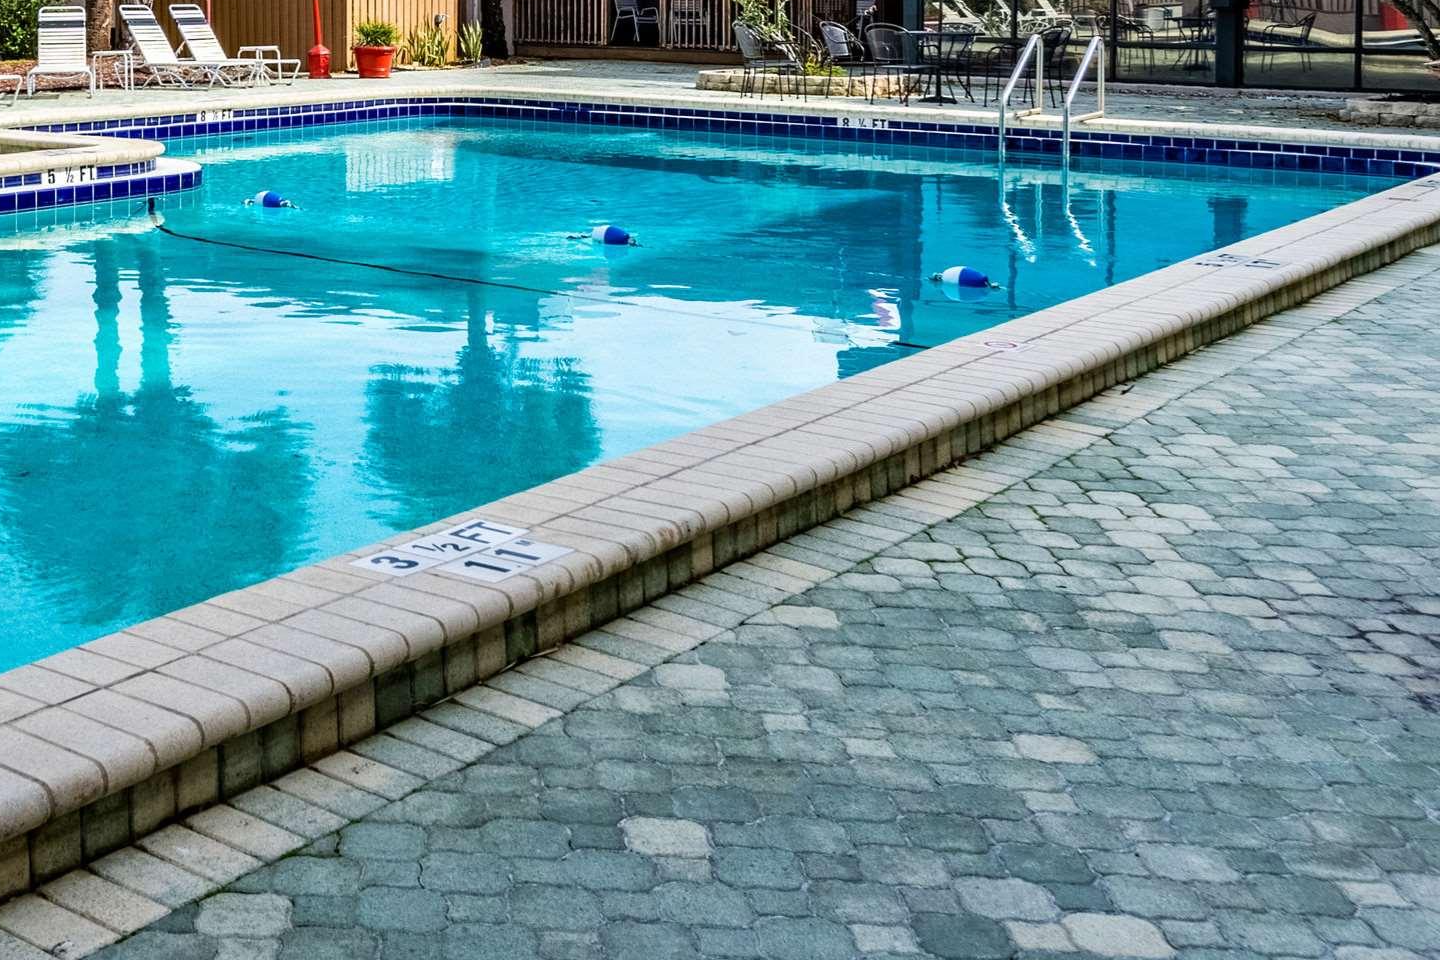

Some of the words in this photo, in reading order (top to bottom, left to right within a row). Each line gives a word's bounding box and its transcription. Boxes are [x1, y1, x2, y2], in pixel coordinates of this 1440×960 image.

[200, 110, 206, 122] 8
[48, 168, 56, 185] 5
[370, 555, 420, 570] 3
[449, 520, 514, 545] FT
